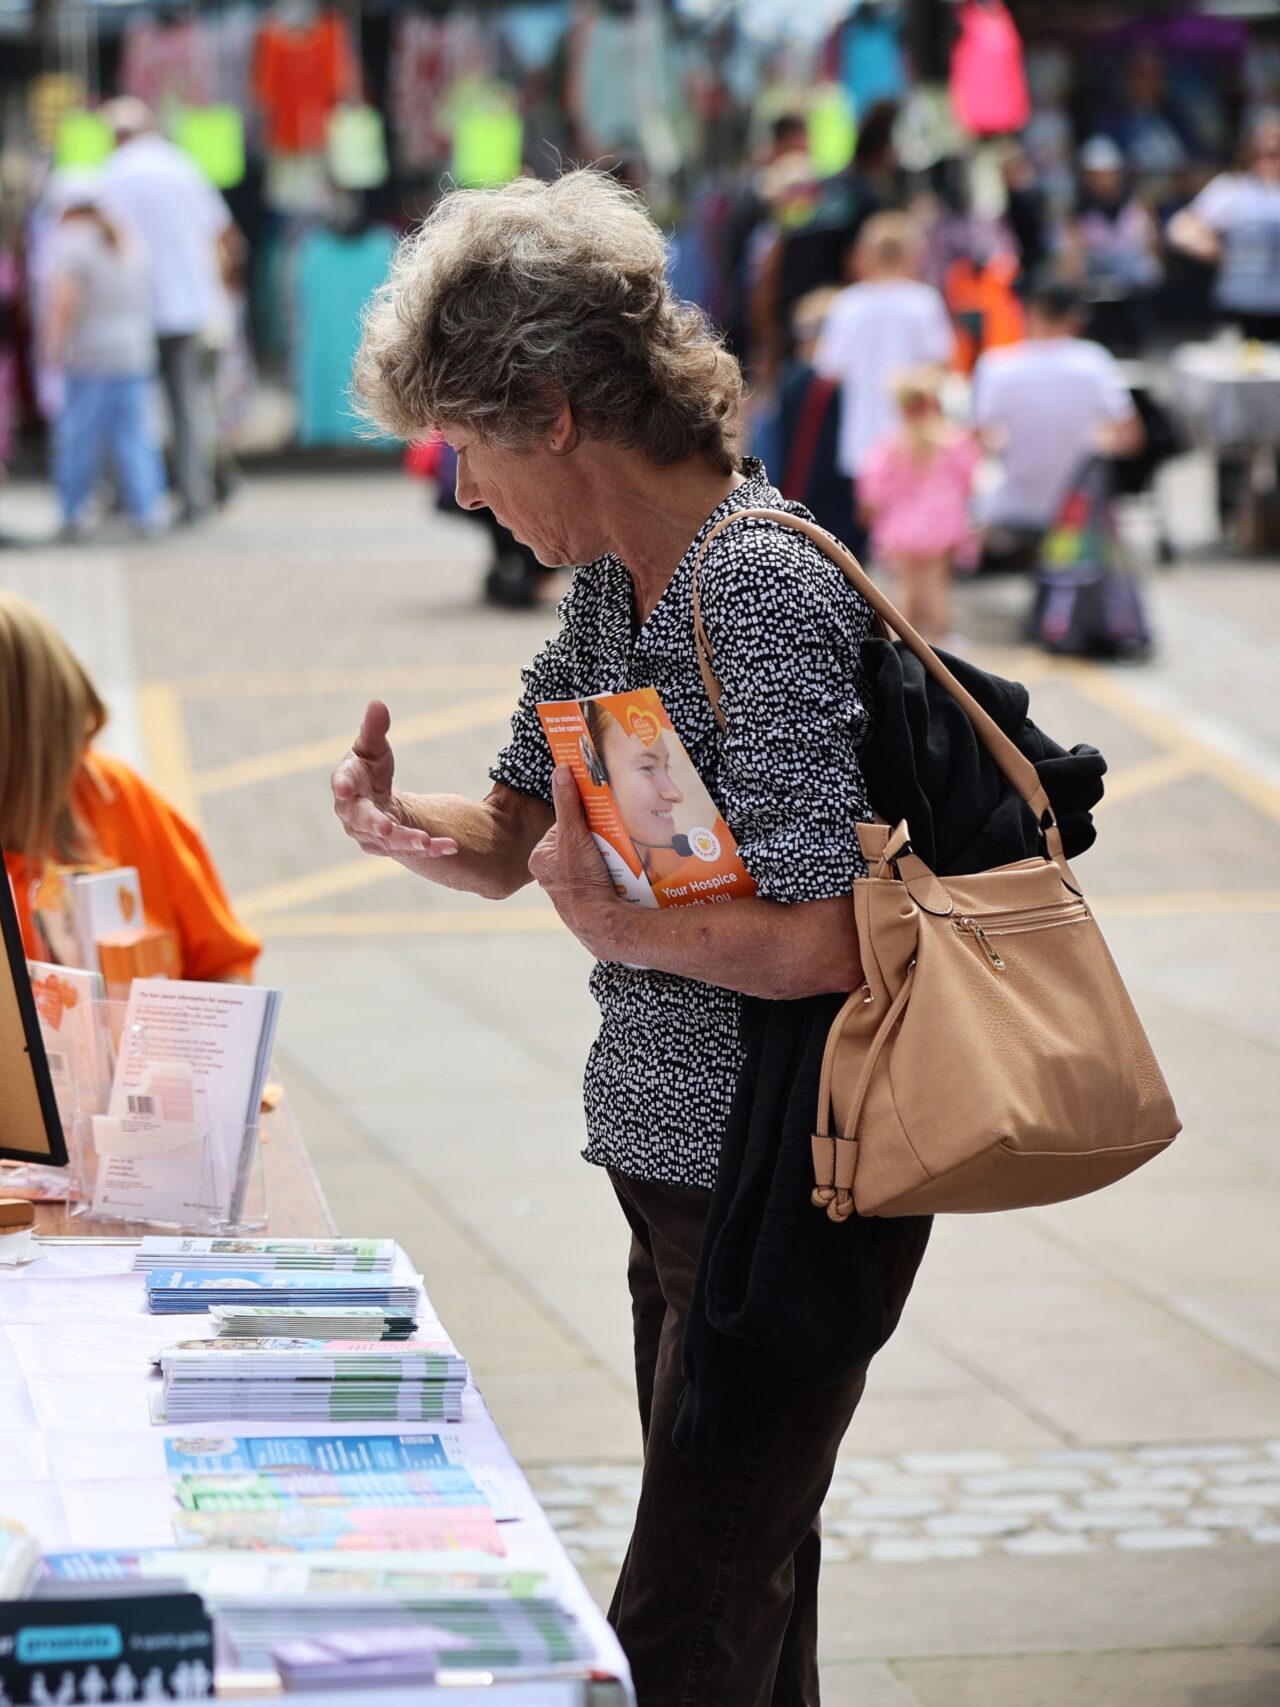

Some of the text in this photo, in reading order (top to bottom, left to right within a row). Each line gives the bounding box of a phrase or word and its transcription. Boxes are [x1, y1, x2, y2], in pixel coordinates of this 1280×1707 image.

[662, 873, 738, 899] Your Hospice
[707, 893, 732, 904] You
